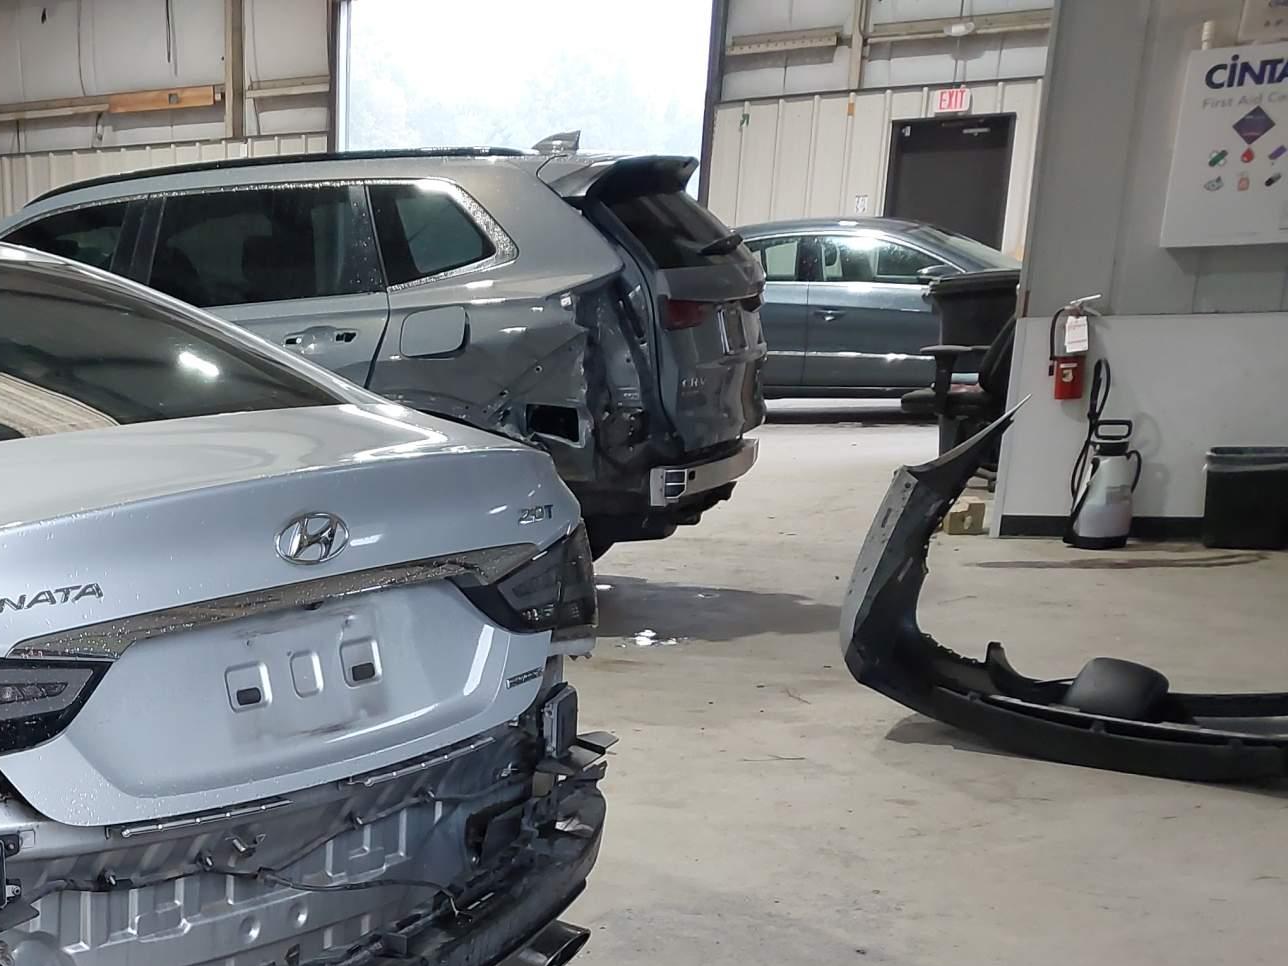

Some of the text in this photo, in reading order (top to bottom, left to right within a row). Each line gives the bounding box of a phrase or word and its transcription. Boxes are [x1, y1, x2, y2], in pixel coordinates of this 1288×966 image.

[939, 89, 966, 110] EXIT
[1202, 97, 1233, 110] First
[1238, 93, 1263, 105] Aid
